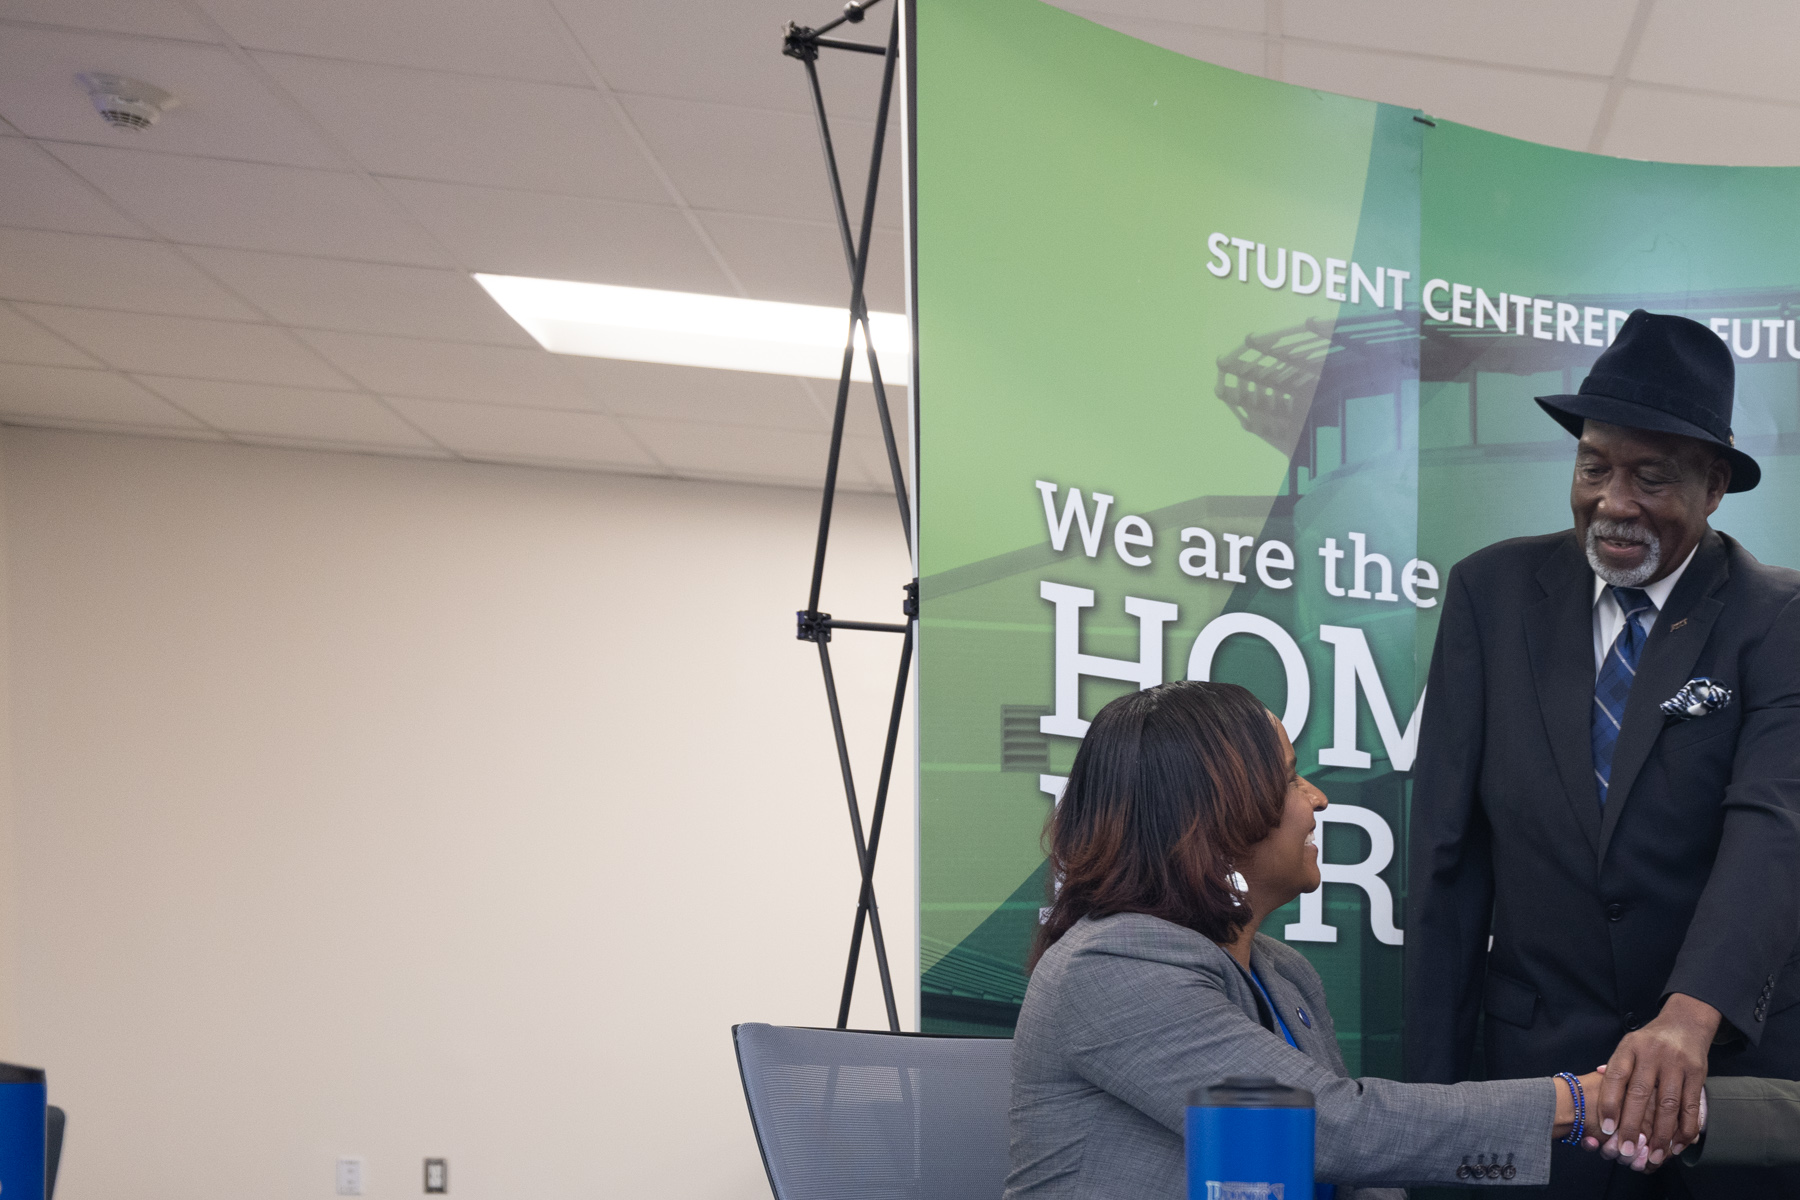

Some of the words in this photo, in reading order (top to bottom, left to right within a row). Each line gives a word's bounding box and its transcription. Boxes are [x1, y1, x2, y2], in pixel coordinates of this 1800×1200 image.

[1206, 232, 1411, 311] STUDENT
[1035, 480, 1154, 568] We
[1178, 526, 1296, 590] are
[1318, 531, 1440, 609] the
[1039, 580, 1428, 772] HOM
